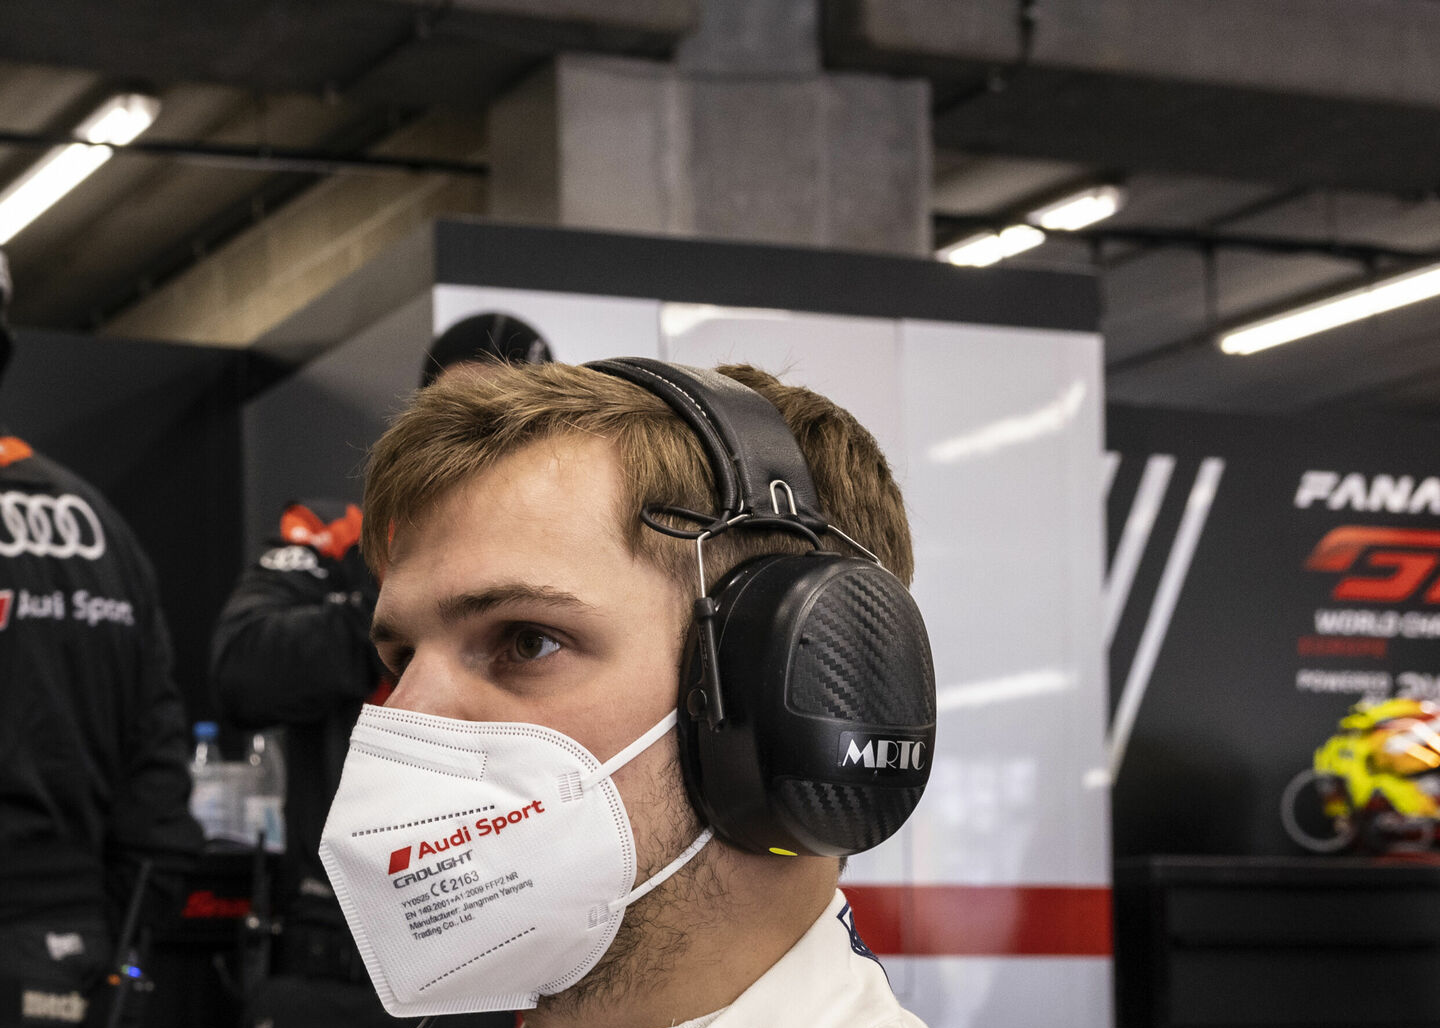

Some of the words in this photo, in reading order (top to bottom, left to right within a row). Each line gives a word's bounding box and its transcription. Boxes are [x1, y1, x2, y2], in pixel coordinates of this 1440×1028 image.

[841, 739, 927, 771] MRTC
[418, 825, 473, 860] Audi
[474, 799, 547, 838] Sport
[393, 849, 474, 890] CADLIGHT
